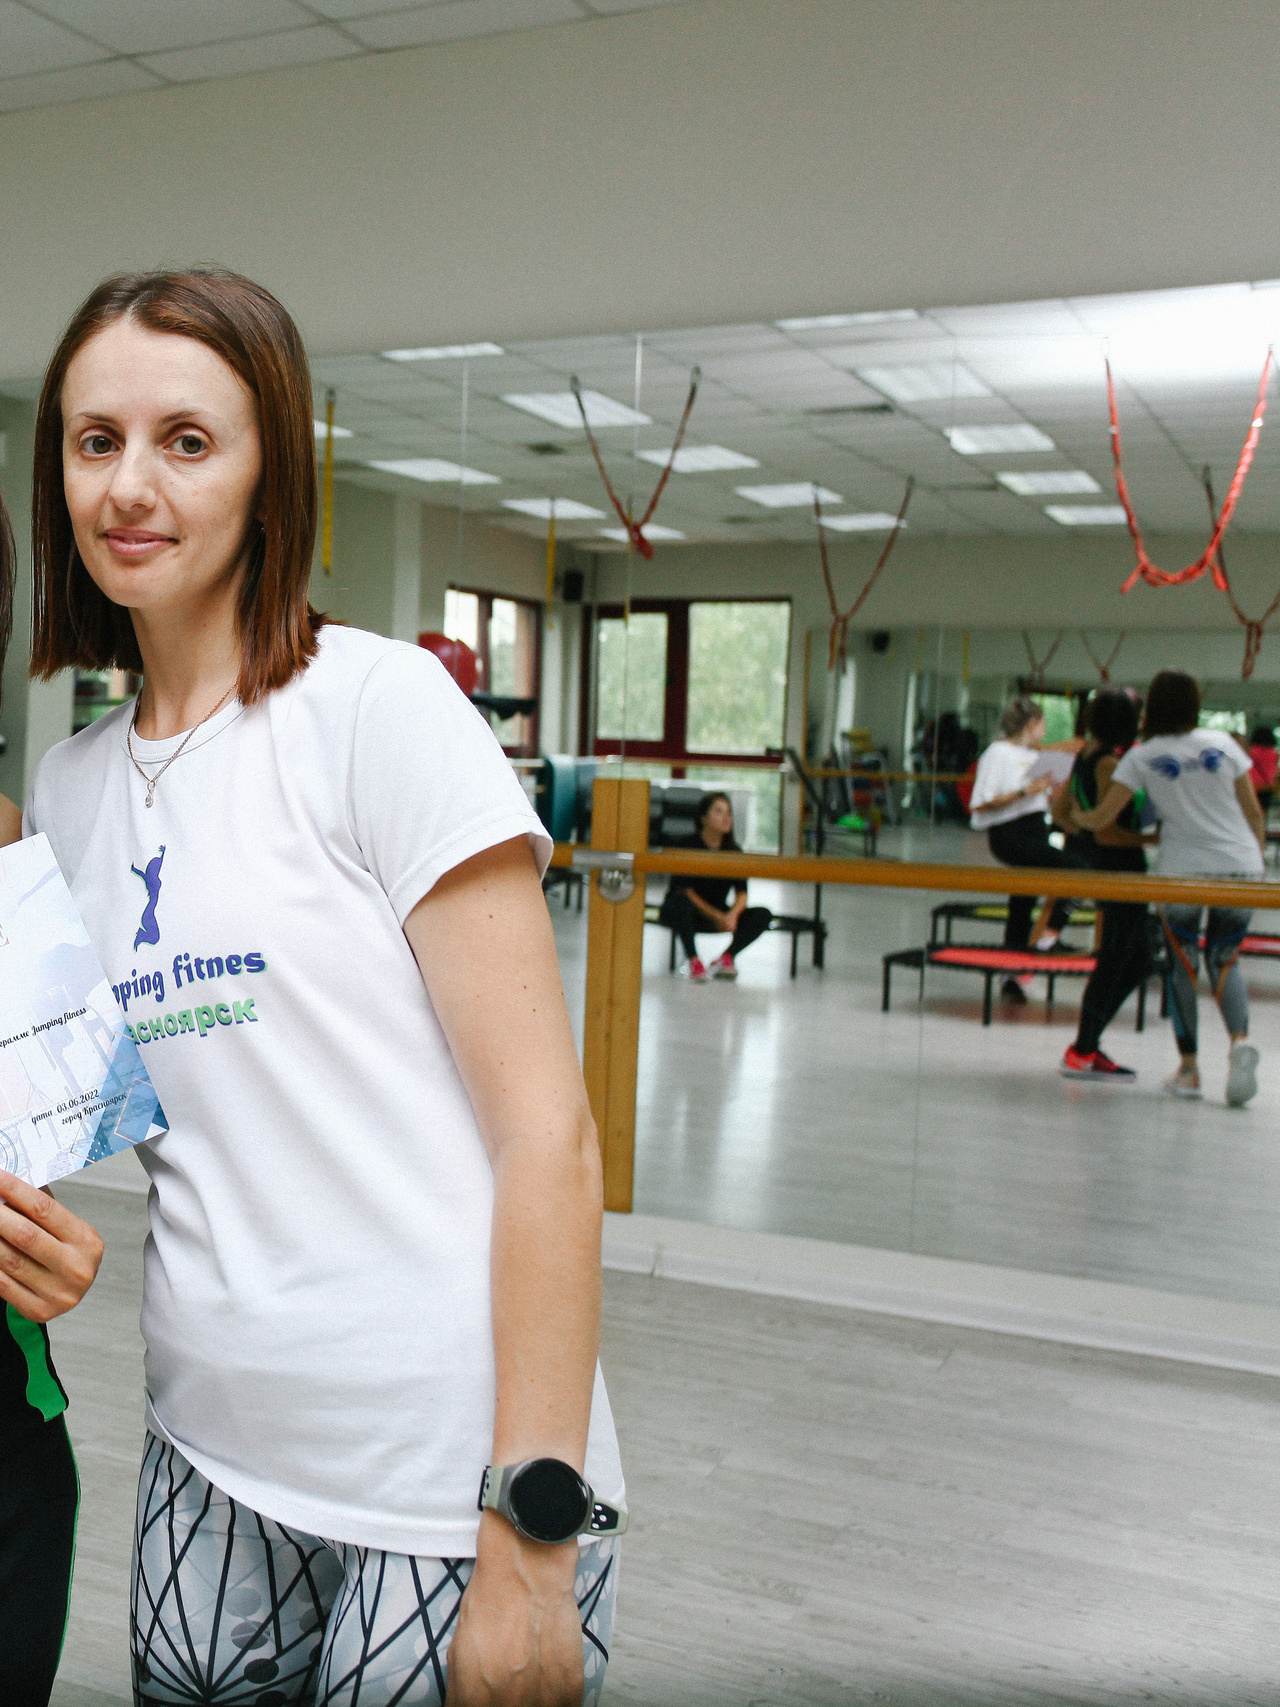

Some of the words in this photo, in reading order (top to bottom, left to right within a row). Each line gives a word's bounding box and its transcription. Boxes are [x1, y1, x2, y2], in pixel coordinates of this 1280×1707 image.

[172, 952, 268, 989] fitnes
[31, 1017, 63, 1037] Jumping
[63, 1006, 87, 1025] fitness
[56, 1088, 100, 1114] 03.06.2022
[83, 1092, 127, 1117] Красноярск
